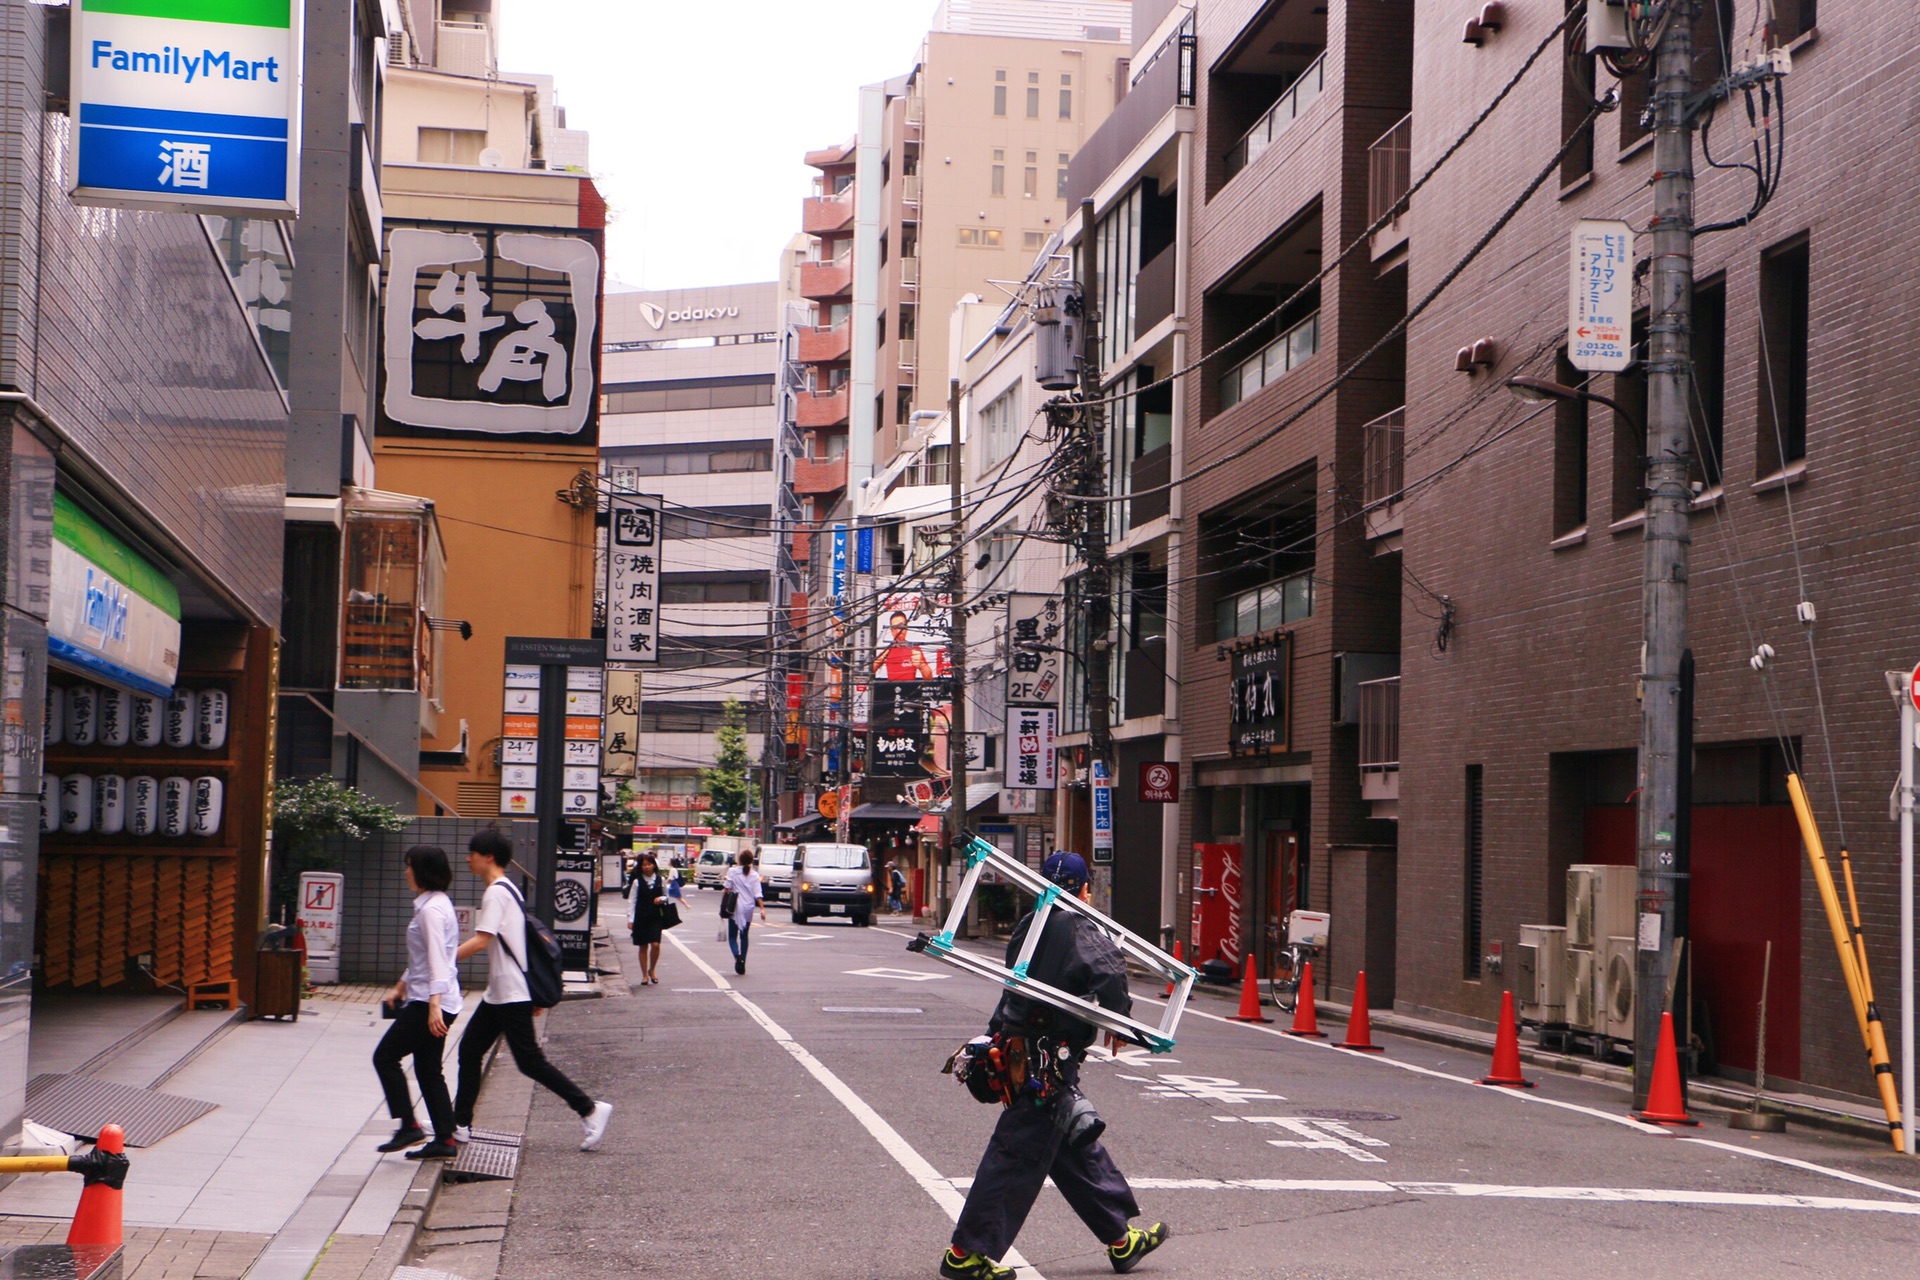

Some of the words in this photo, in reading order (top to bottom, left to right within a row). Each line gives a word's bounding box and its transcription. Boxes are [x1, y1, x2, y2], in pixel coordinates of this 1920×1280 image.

[91, 41, 279, 83] FamilyMart
[157, 139, 211, 190] 酒
[1590, 254, 1601, 313] アカデミー
[1603, 234, 1614, 293] ヒューマン
[1576, 349, 1623, 358] 297-428
[613, 553, 626, 652] Gyu-Kaku
[628, 554, 655, 652] 焼肉酒家
[1011, 682, 1033, 698] 2F
[507, 741, 534, 751] 24/7
[569, 743, 595, 753] 24/7
[1019, 710, 1040, 785] 一軒め酒場
[1096, 790, 1109, 828] セキネ
